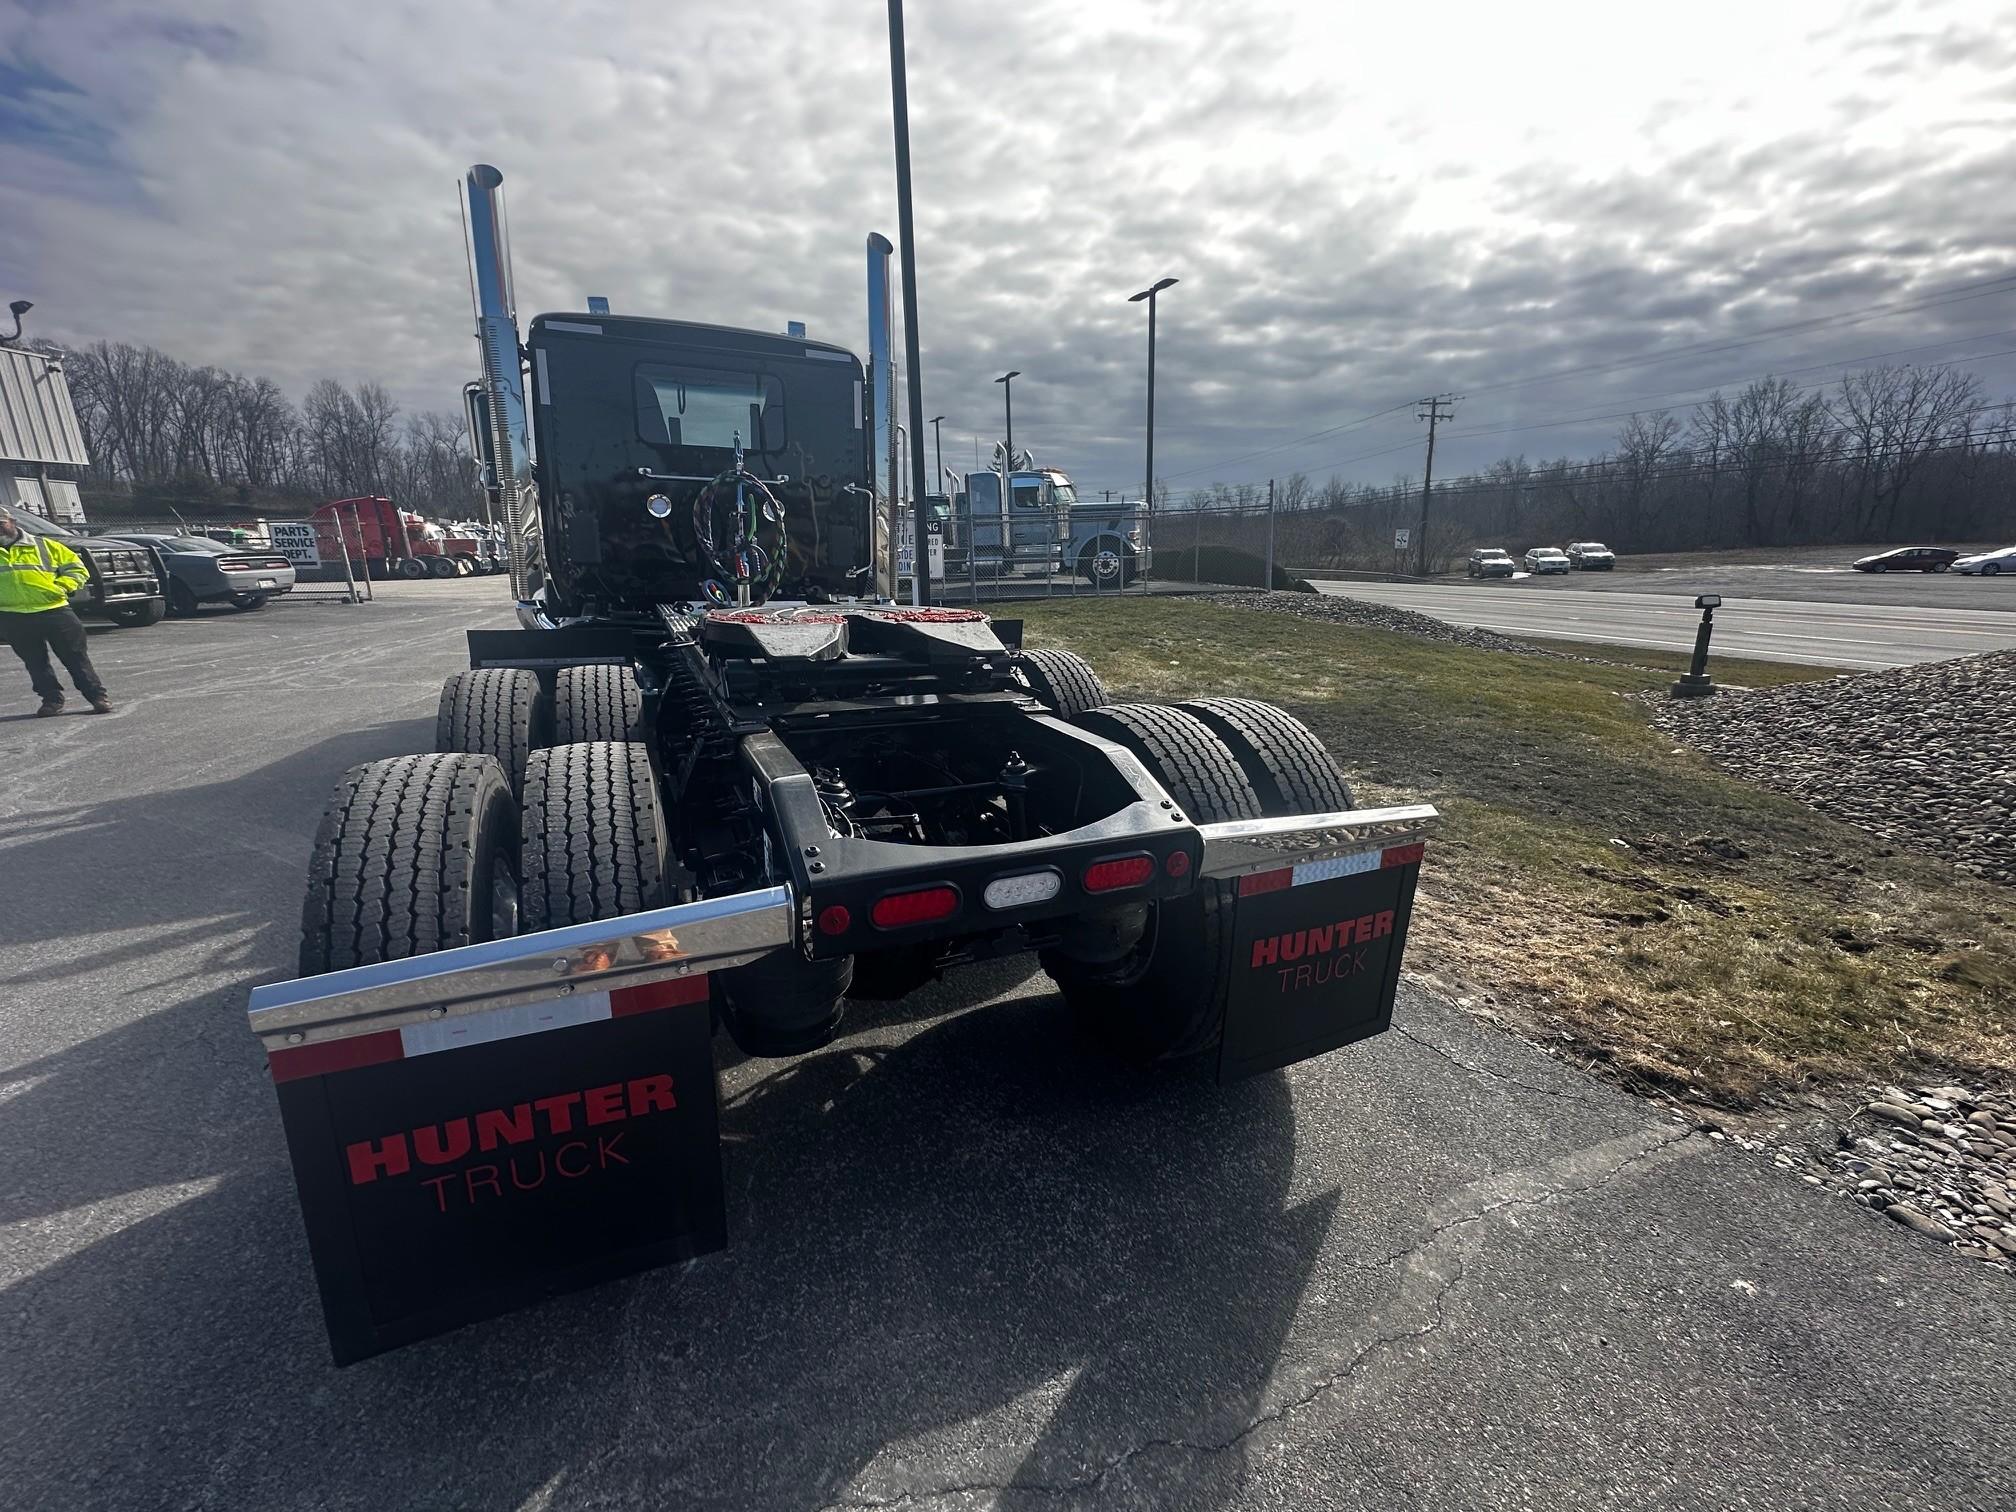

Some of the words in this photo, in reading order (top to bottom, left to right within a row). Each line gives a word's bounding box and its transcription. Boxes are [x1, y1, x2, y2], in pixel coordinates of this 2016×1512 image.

[274, 526, 309, 536] PARTS
[274, 538, 315, 547] SERVICE
[283, 549, 312, 559] DEPT.
[1252, 910, 1395, 968] HUNTER
[1277, 948, 1367, 993] TRUCK
[347, 1073, 677, 1185] HUNTER
[421, 1132, 631, 1213] TRUCK
